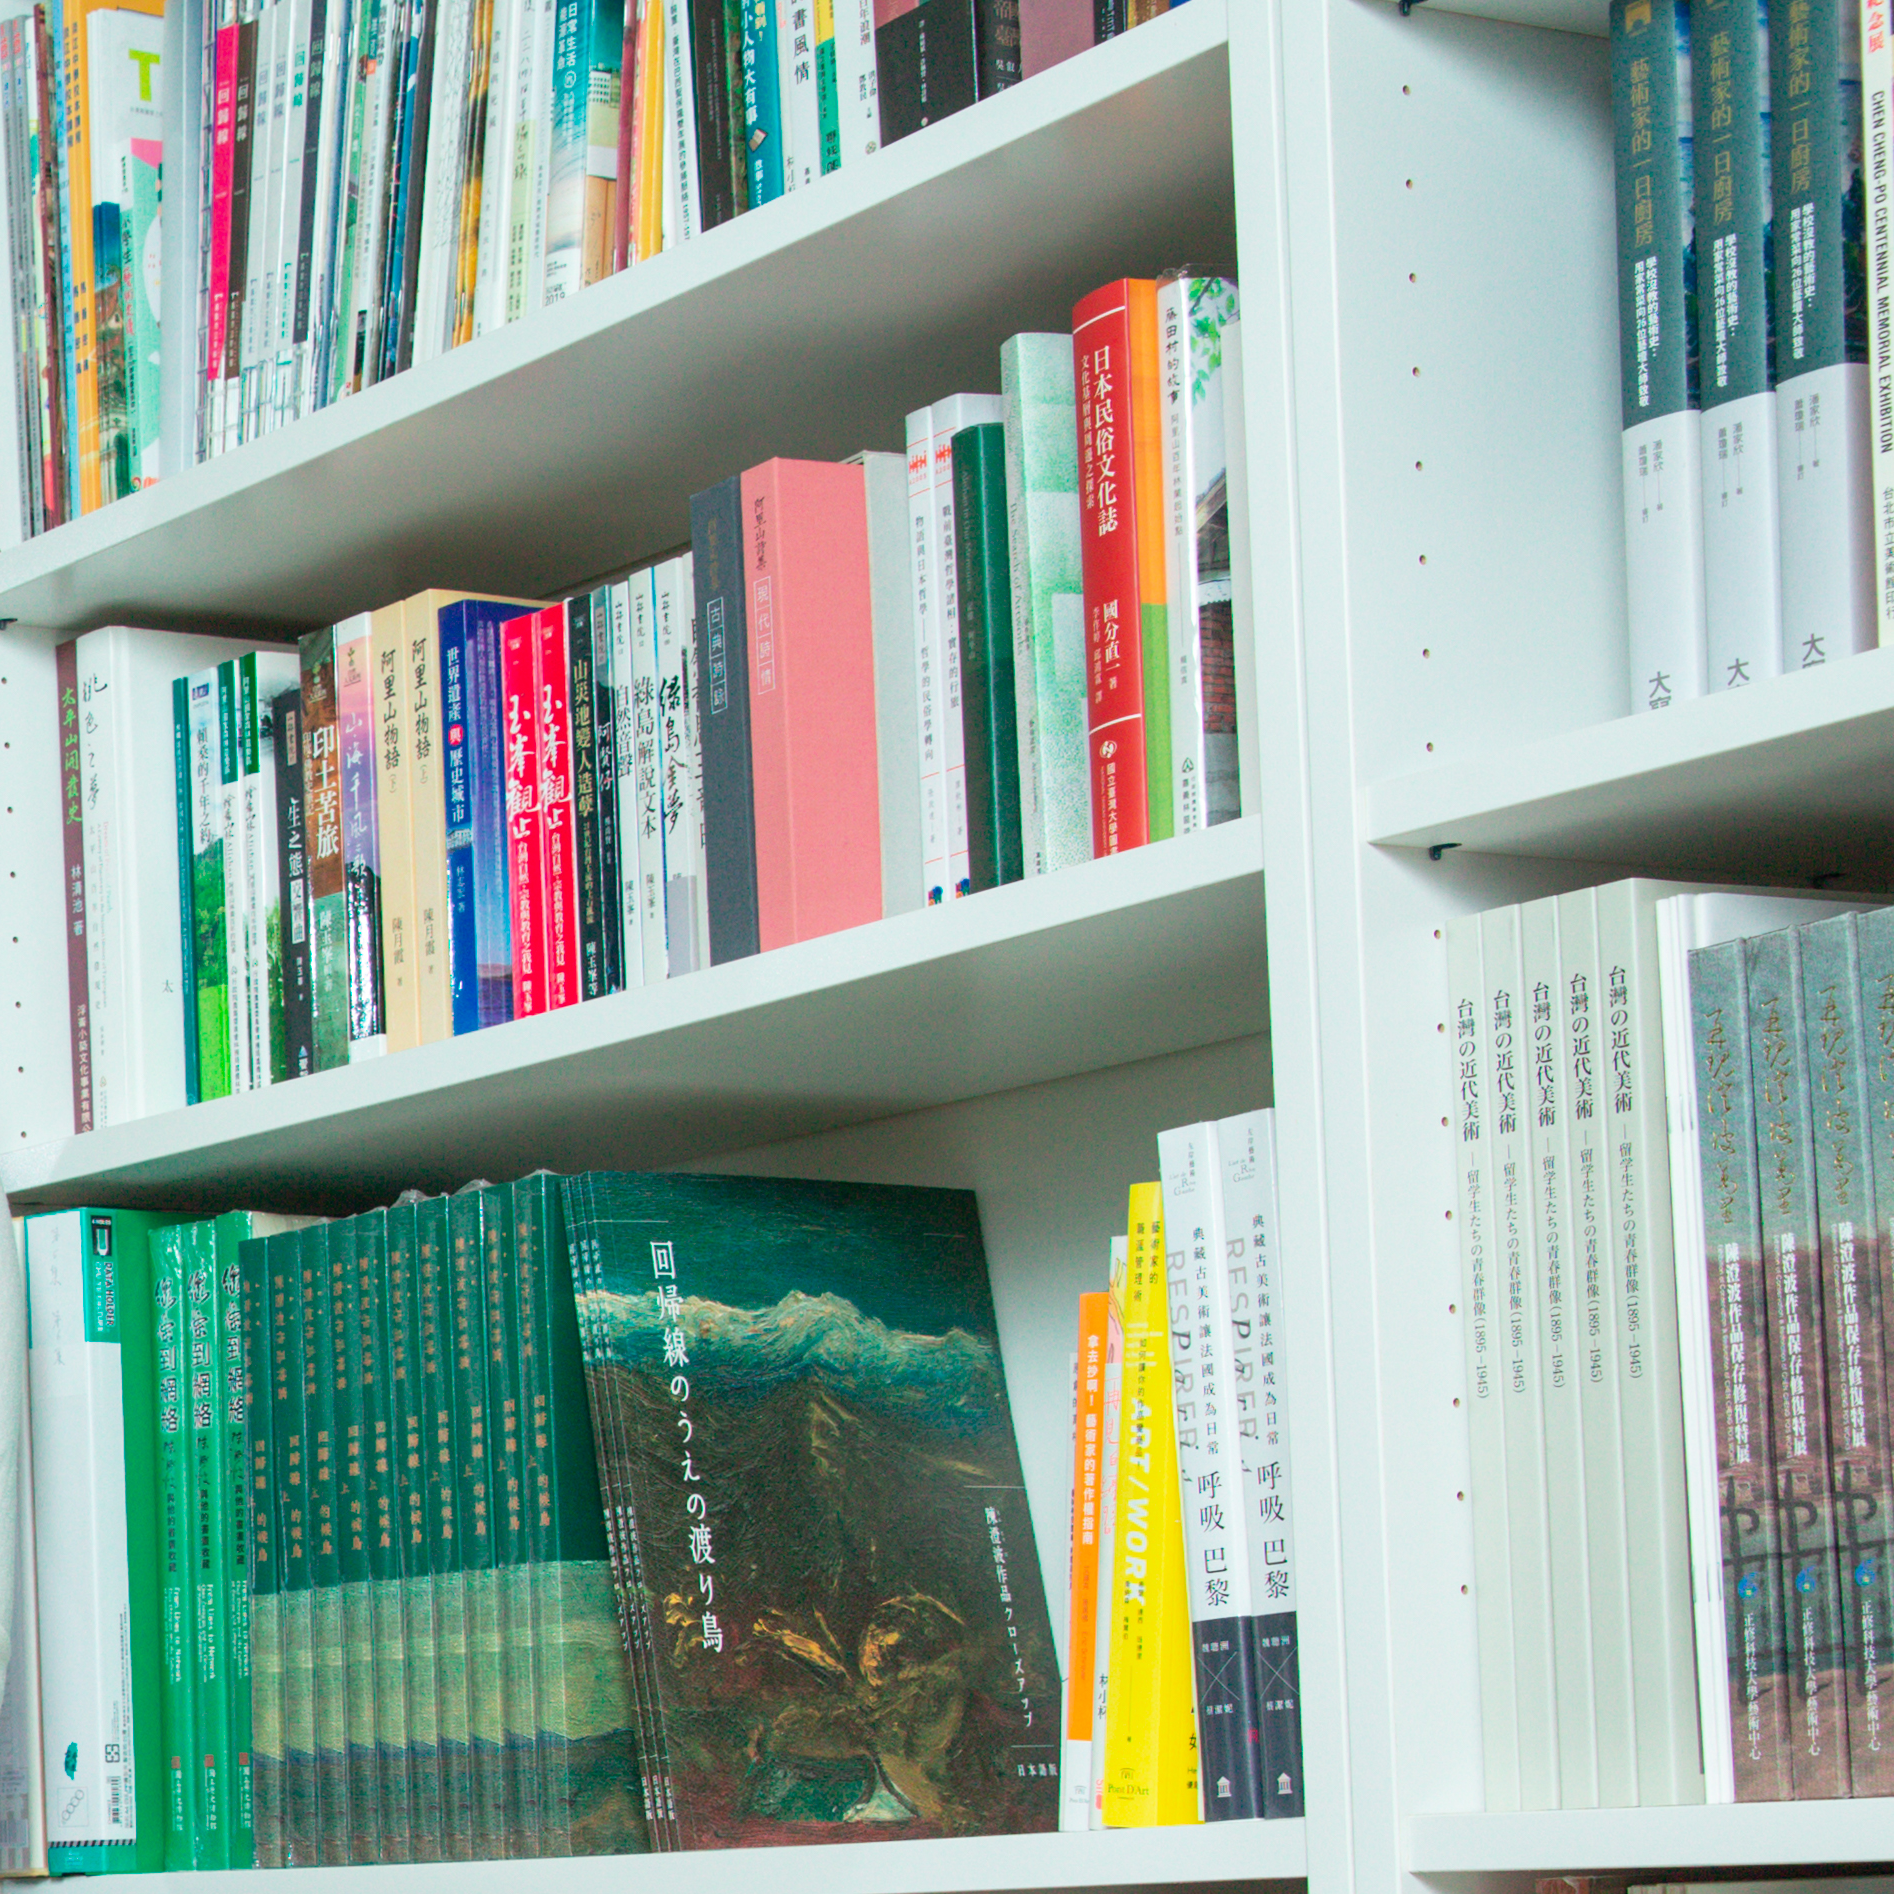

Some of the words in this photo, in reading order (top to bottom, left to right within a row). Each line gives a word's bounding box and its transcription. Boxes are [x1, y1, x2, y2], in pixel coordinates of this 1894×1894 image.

[1871, 89, 1886, 131] CHEN
[1872, 131, 1889, 205] CHENG-PO
[1872, 206, 1890, 294] CENTENNIAL
[1876, 295, 1891, 373] MEMORIAL
[1093, 345, 1118, 537] 日本民俗文化誌
[1878, 374, 1894, 455] EXHIBITION
[1102, 598, 1121, 672] 國分直一
[380, 648, 401, 771] 阿里山物語
[411, 637, 432, 761] 阿里山物語
[311, 724, 341, 861] 印土苦旅
[1457, 997, 1481, 1143] 台灣の近代美術
[1492, 989, 1517, 1136] 台灣の近代美術
[1532, 980, 1557, 1128] 台灣の近代美術
[1569, 972, 1595, 1121] 台灣の近代美術
[1608, 964, 1634, 1115] 台灣の近代美術
[1191, 1225, 1220, 1457] 典藏古美術讓法國成為日常
[1251, 1212, 1281, 1447] 典藏古美術讓法國成為日常
[648, 1239, 726, 1654] 回帰線のうえの渡り鳥
[1196, 1469, 1226, 1533] 呼吸
[1257, 1460, 1285, 1525] 呼吸
[1203, 1545, 1230, 1608] 巴黎
[1263, 1537, 1290, 1600] 巴黎
